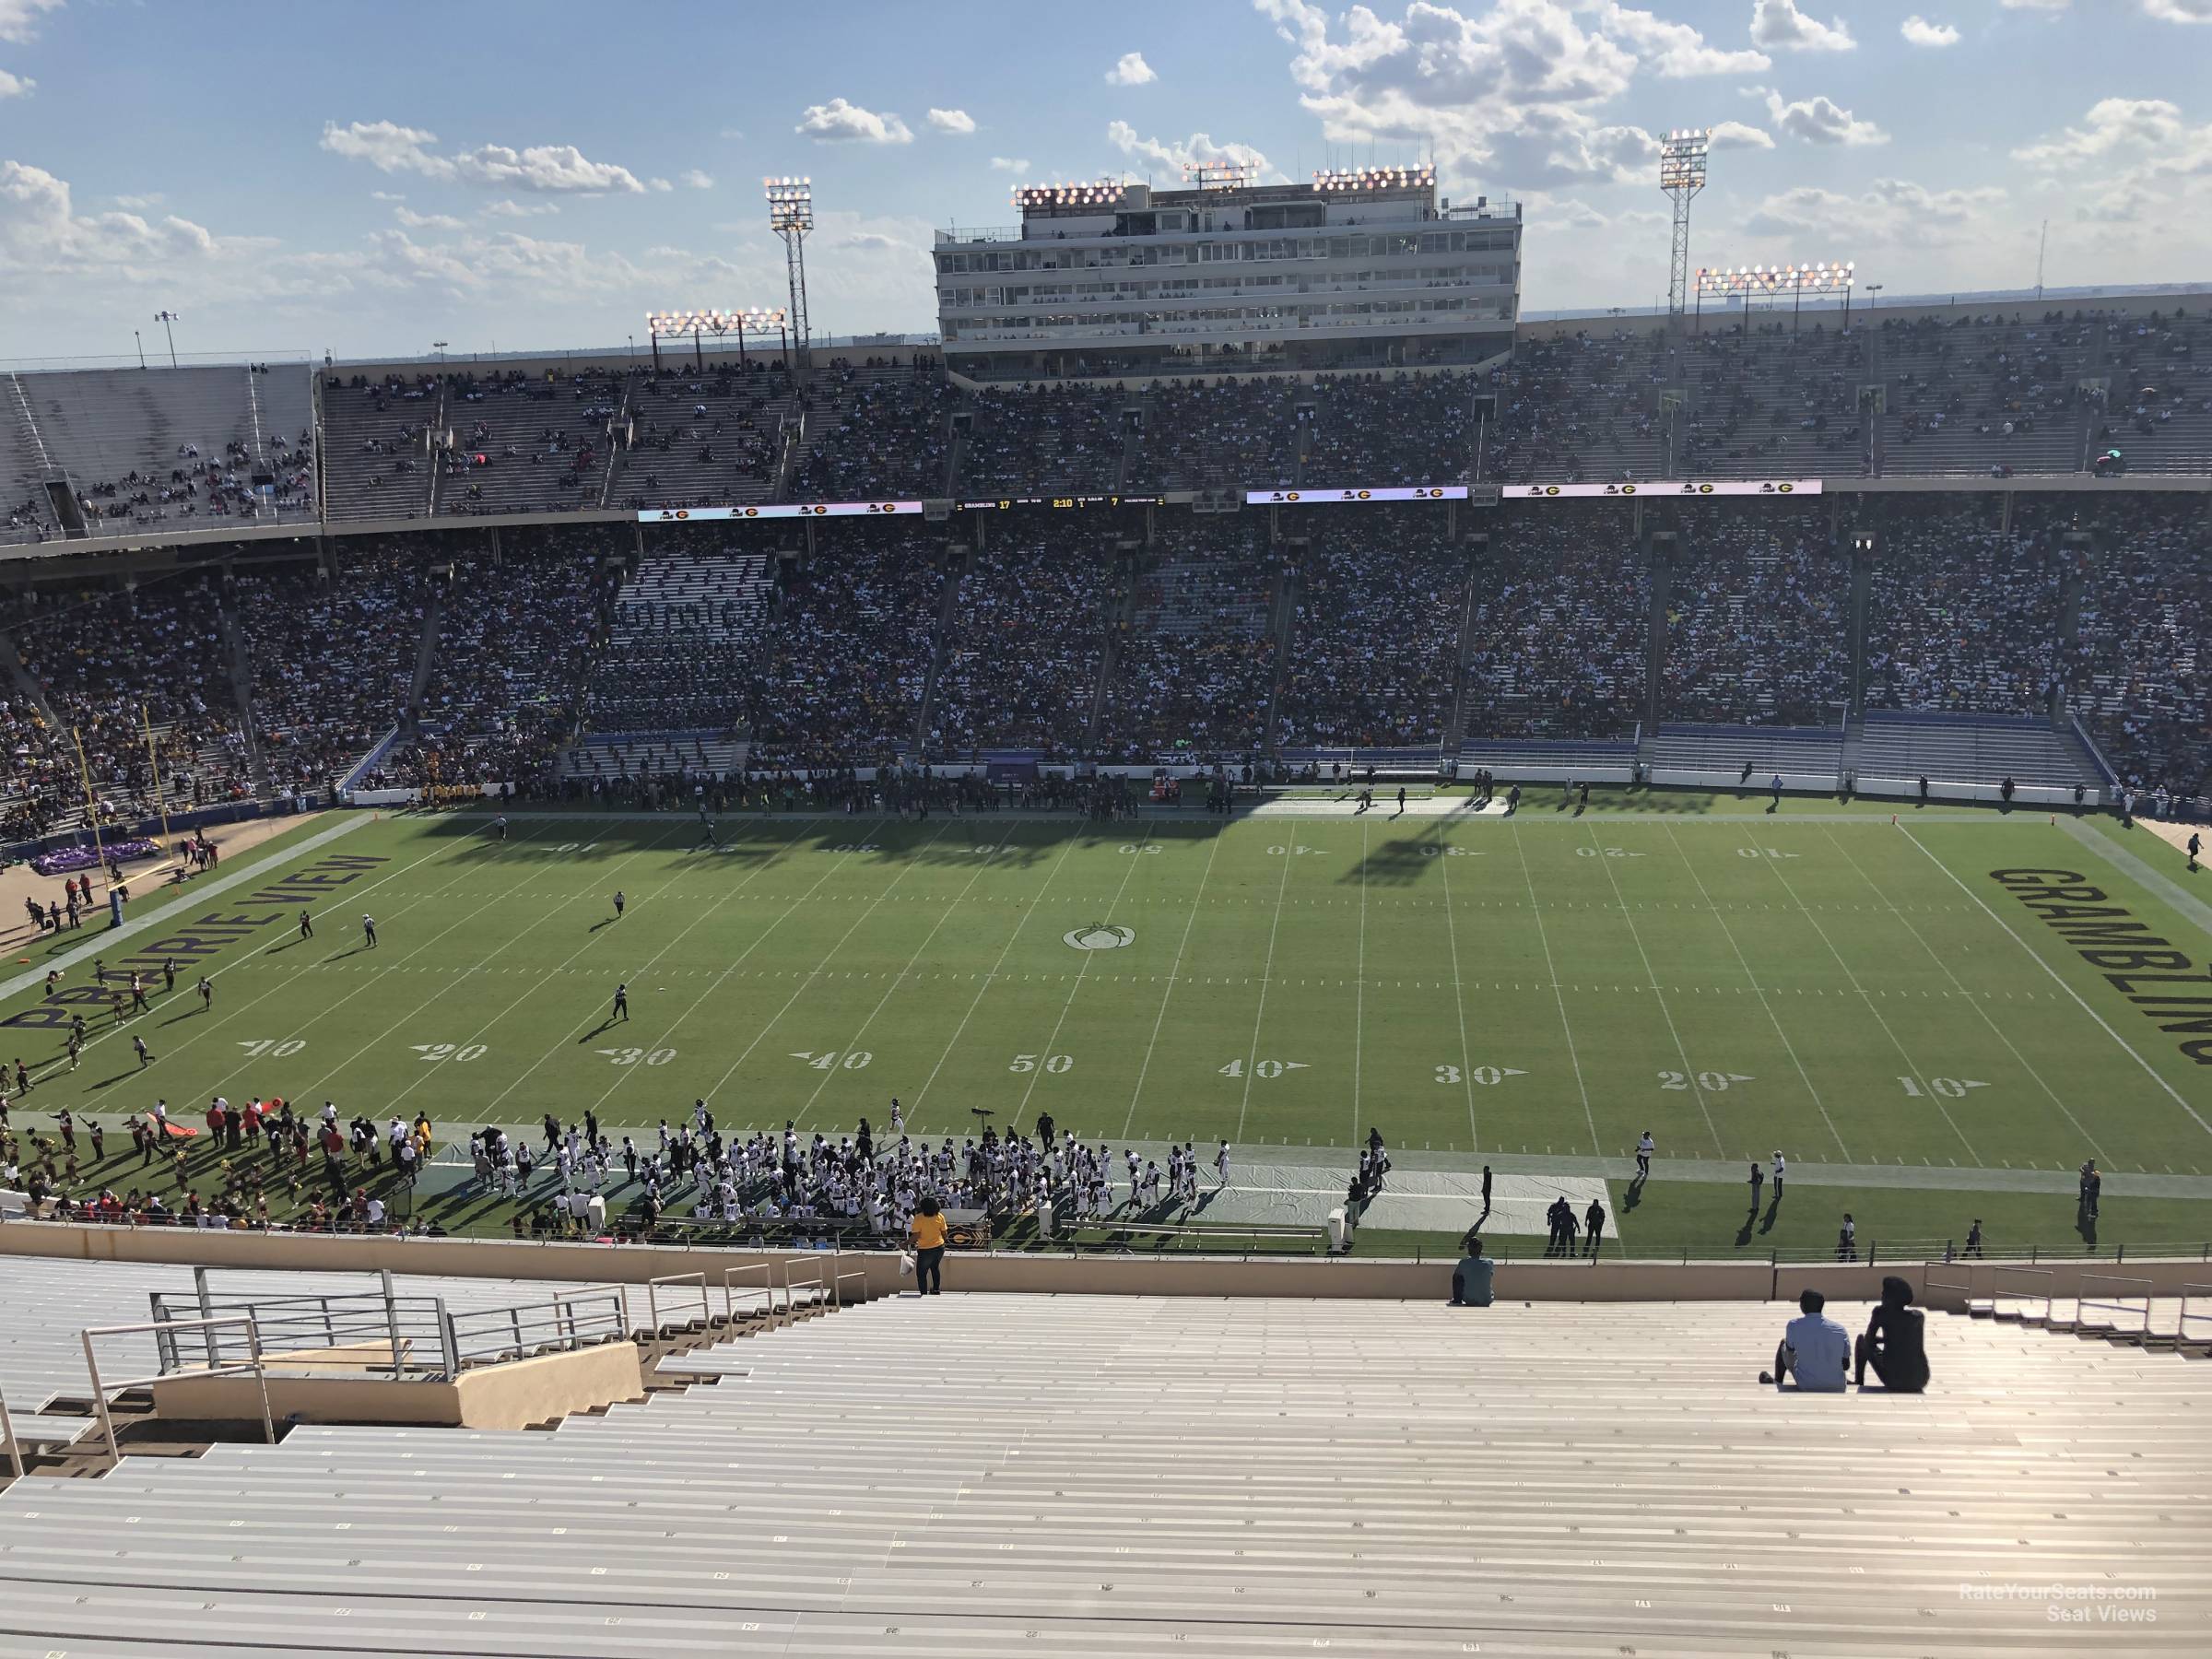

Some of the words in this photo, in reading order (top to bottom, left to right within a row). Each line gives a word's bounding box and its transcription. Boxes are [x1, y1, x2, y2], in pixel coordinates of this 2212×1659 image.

[999, 500, 1010, 509] 17
[1053, 499, 1073, 508] 2:10
[1112, 498, 1118, 506] 7
[234, 854, 392, 906] VIEW
[242, 1039, 307, 1057] 10
[418, 1042, 488, 1062] 20
[609, 1047, 677, 1066] 30
[807, 1051, 874, 1070] 40
[1007, 1053, 1074, 1075] 50
[1218, 1058, 1284, 1078] 40
[1433, 1064, 1502, 1085] 30
[1657, 1070, 1730, 1092] 20
[1896, 1077, 1967, 1098] 10
